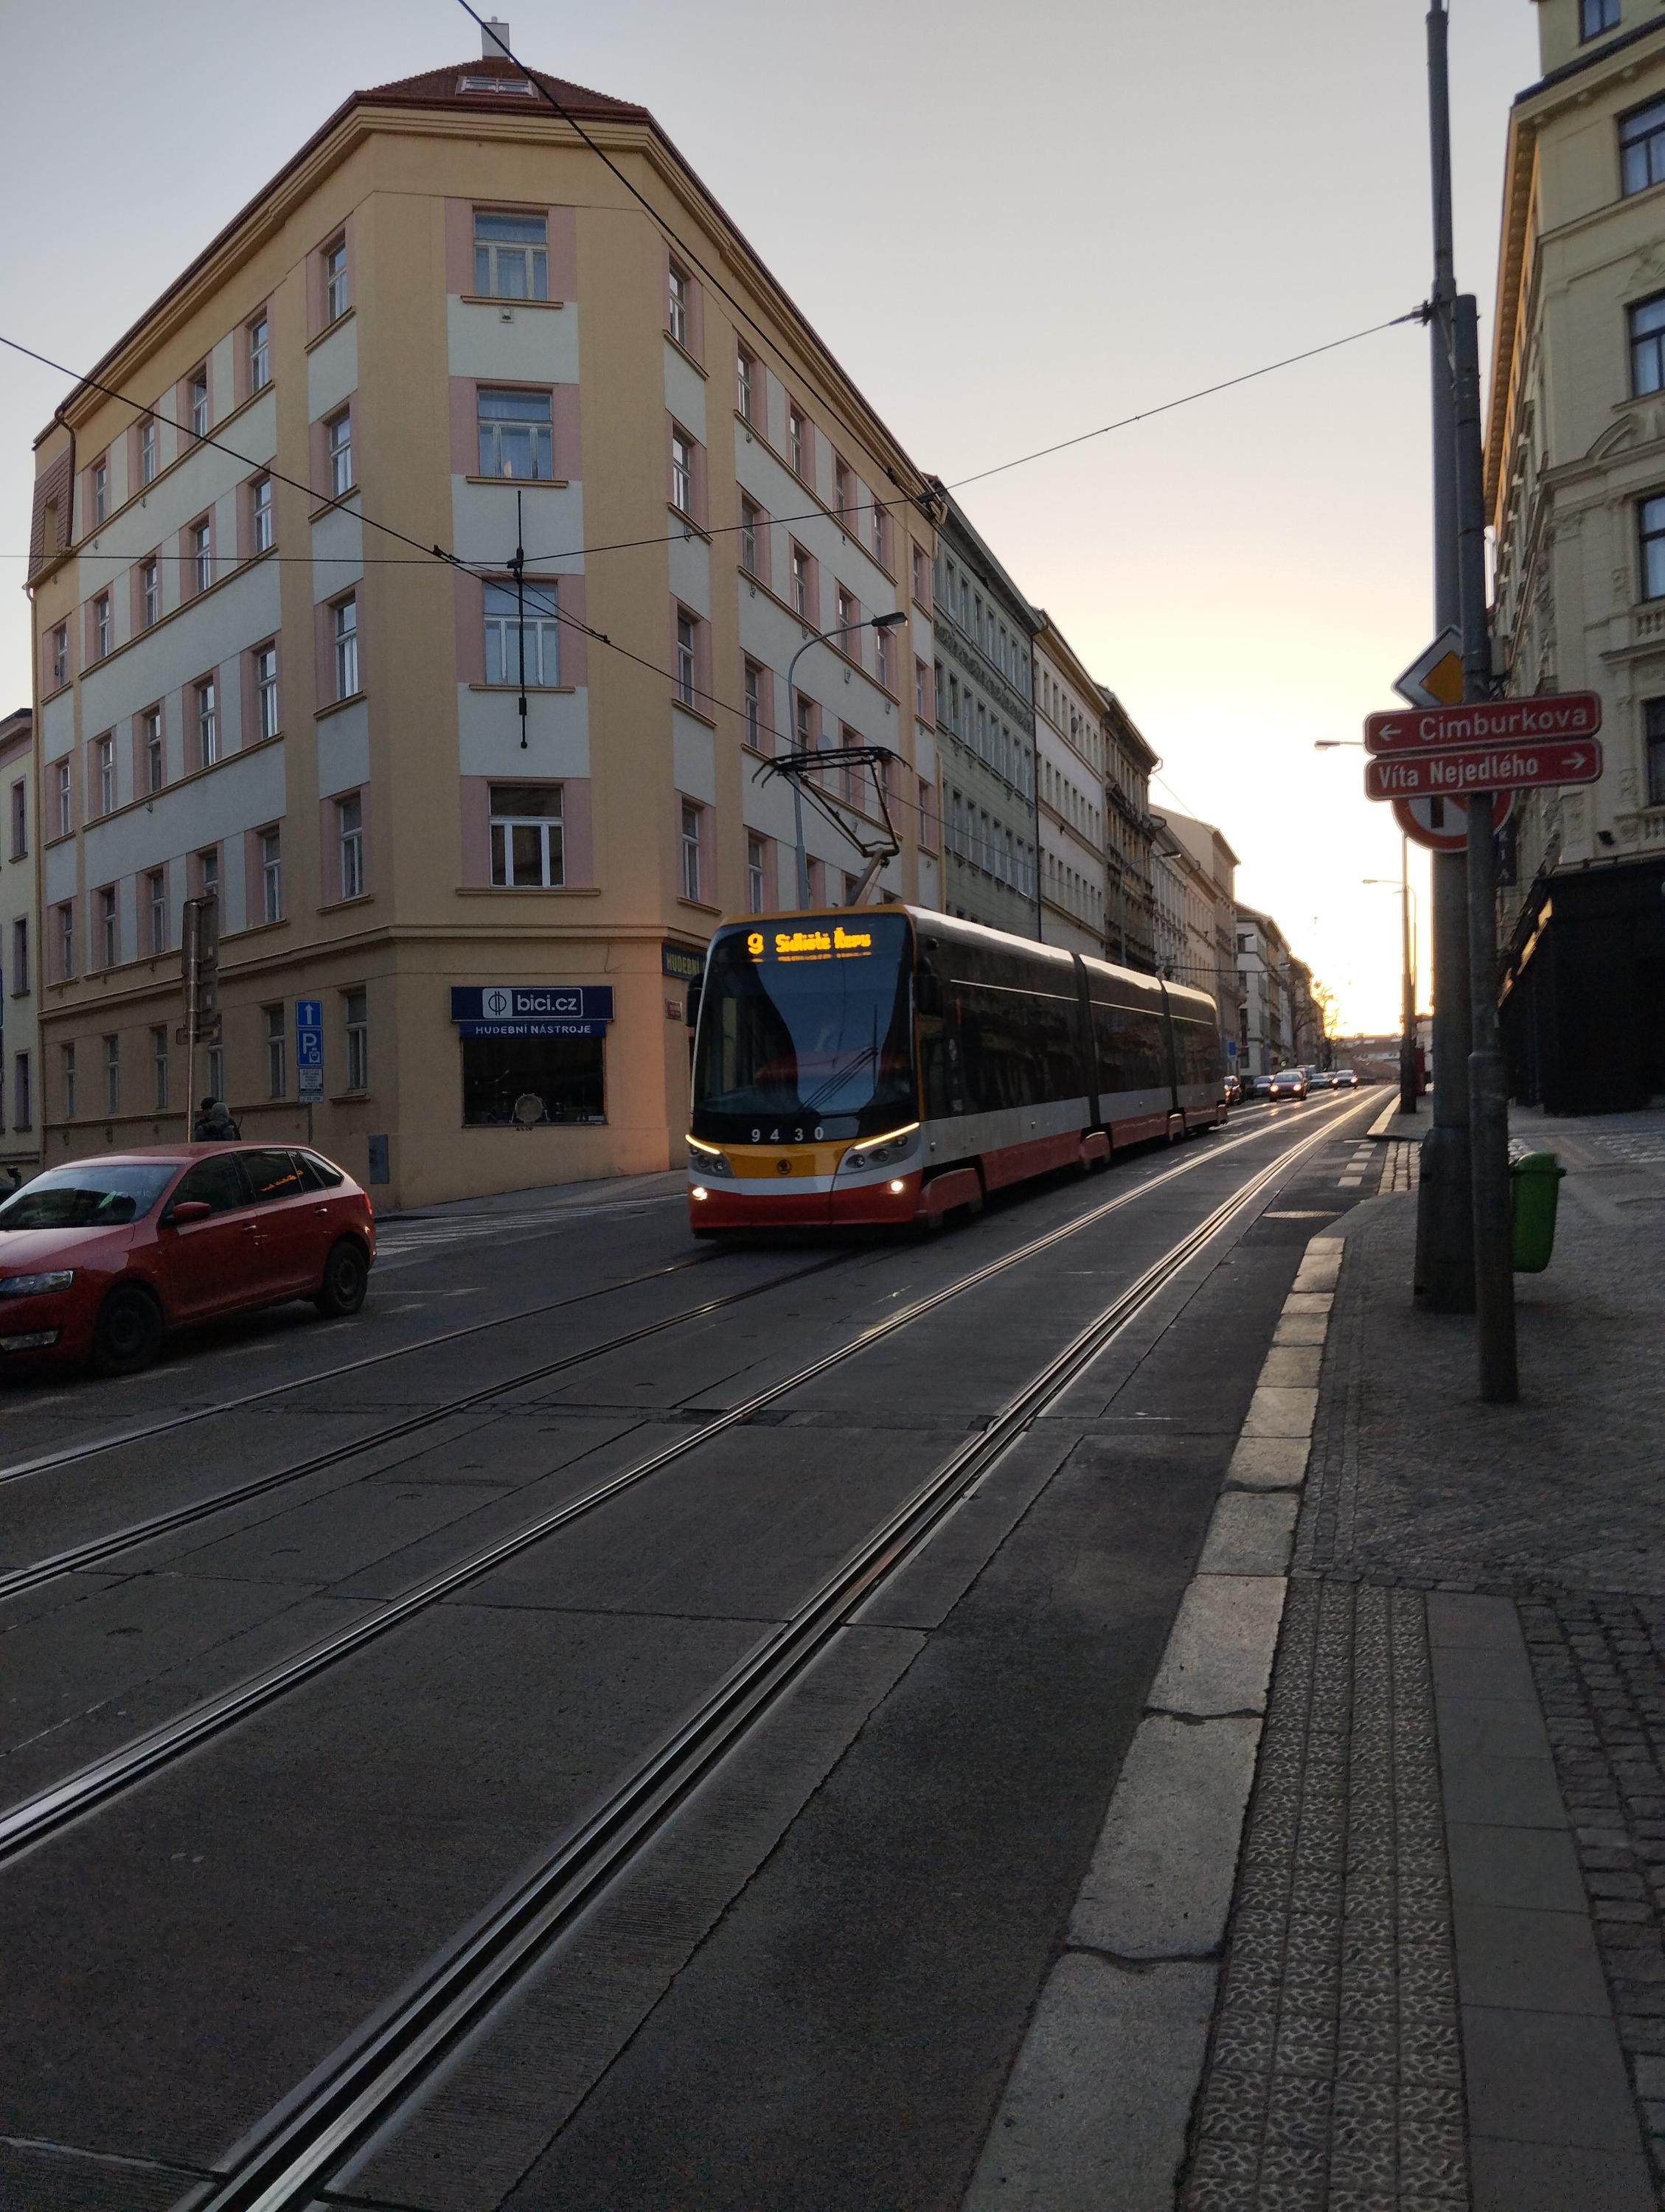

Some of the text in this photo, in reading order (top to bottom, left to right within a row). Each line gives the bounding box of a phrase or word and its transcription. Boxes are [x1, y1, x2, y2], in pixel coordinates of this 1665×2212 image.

[1419, 707, 1588, 740] Cimburkova
[1379, 754, 1538, 789] Víta Nejedlého
[747, 933, 764, 955] 9
[517, 994, 577, 1011] bici.cz
[476, 1023, 591, 1034] HUDEBNÍ NÁSTROJE
[302, 1032, 318, 1054] P
